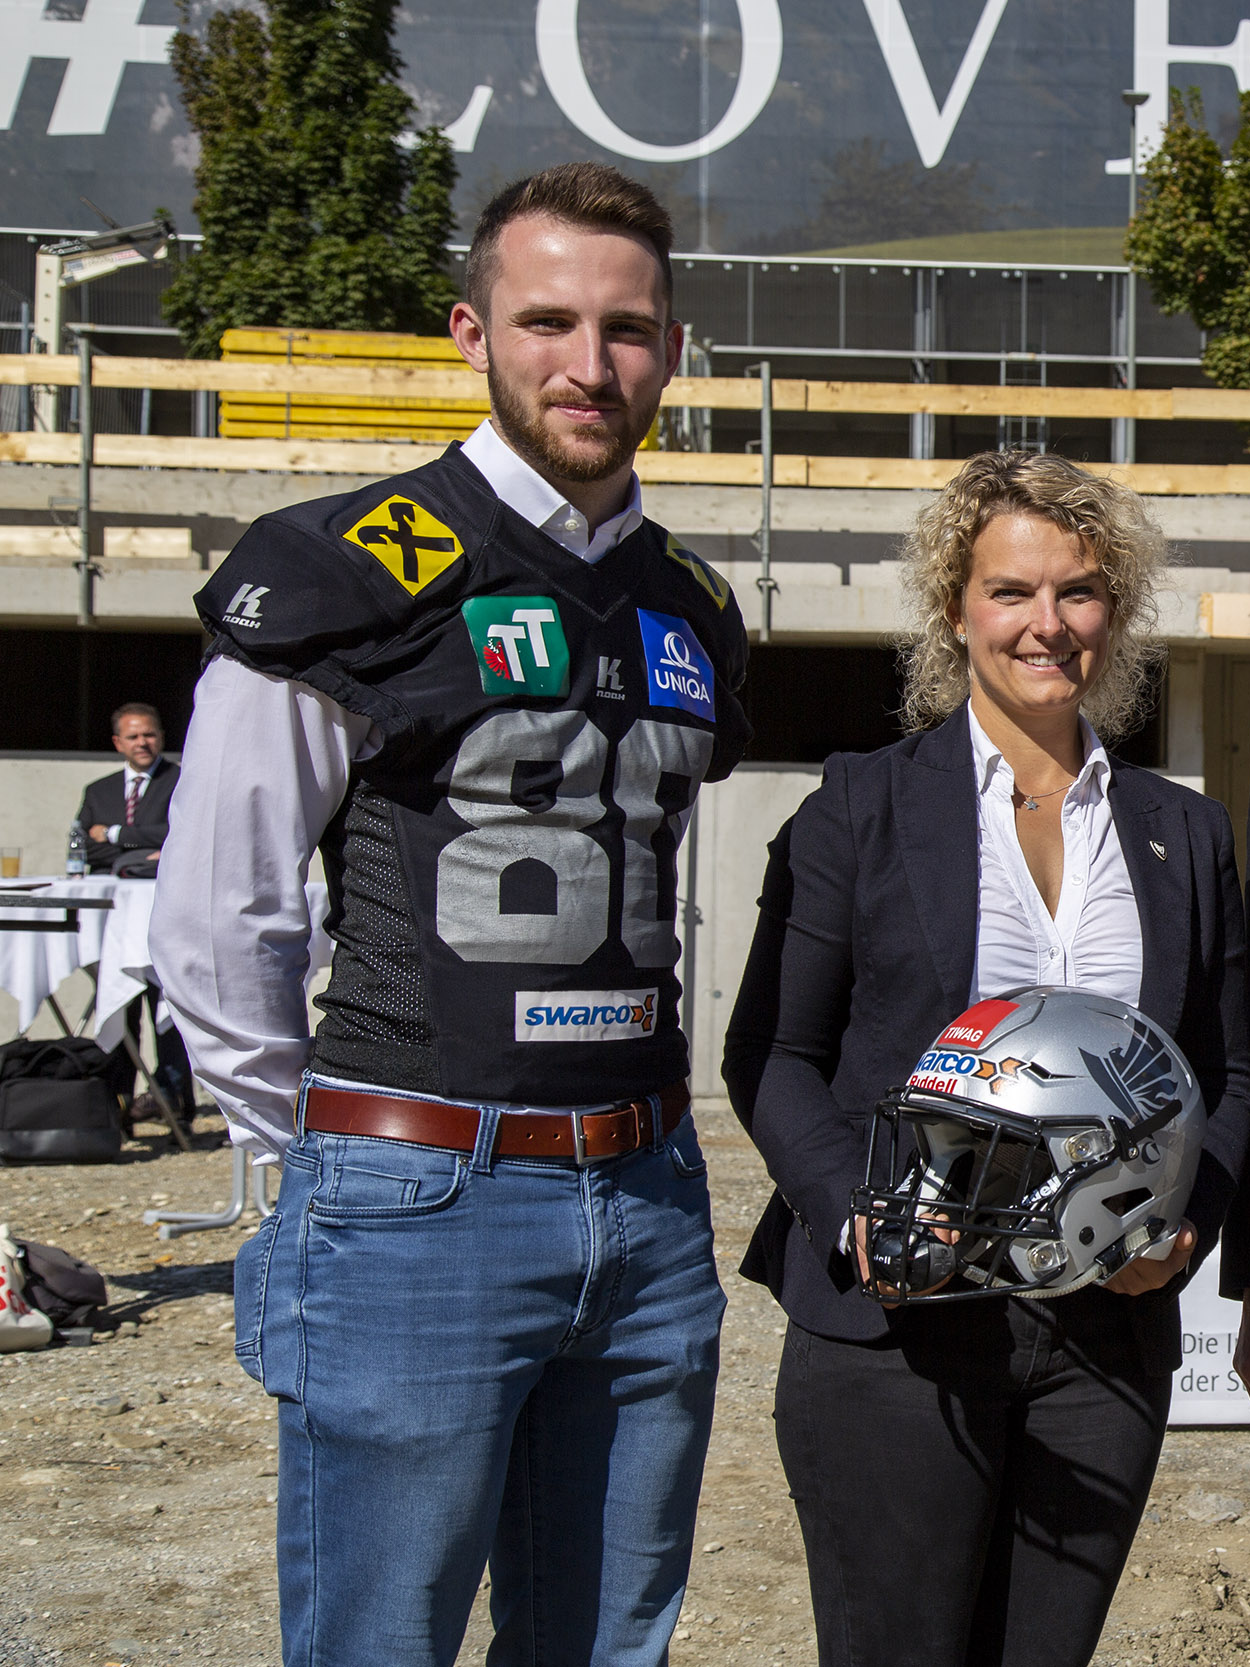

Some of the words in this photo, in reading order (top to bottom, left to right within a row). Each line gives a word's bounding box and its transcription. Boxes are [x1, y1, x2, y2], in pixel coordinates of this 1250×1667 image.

[654, 669, 711, 704] UNIQA
[524, 1005, 631, 1027] swarco
[944, 1026, 984, 1043] TIWAG
[909, 1075, 958, 1094] Riddell
[1183, 1332, 1218, 1354] Die
[1180, 1368, 1220, 1392] der
